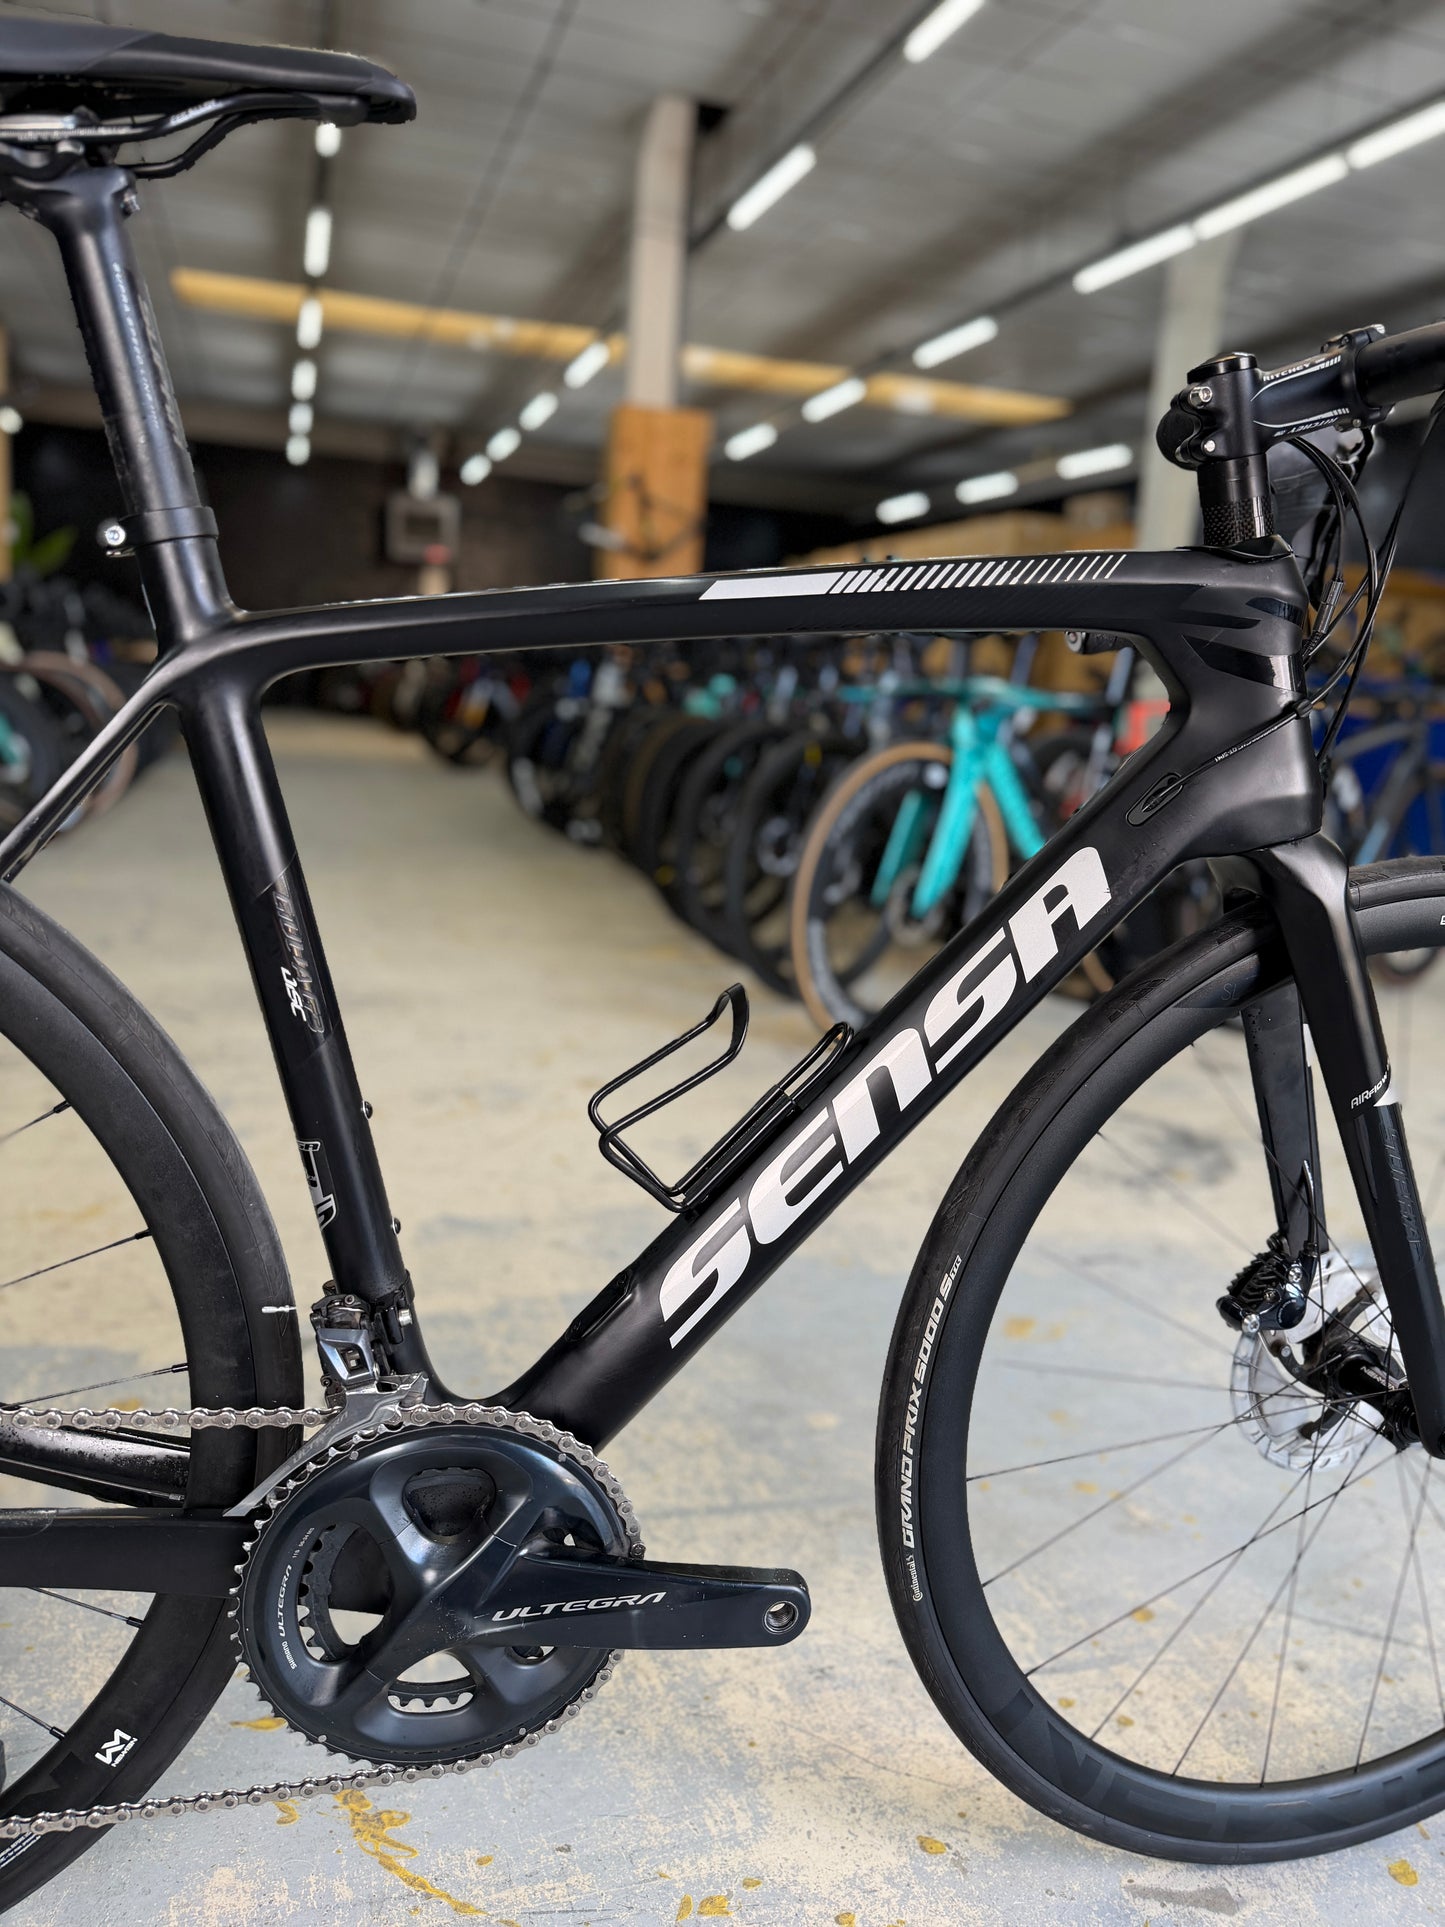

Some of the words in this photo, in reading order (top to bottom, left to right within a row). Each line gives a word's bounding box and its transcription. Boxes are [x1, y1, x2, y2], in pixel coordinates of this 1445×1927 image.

[1263, 363, 1311, 382] RITCHEY
[1287, 416, 1339, 435] RITCHEY
[940, 1273, 953, 1301] S
[913, 1297, 945, 1385] 5000
[902, 1382, 923, 1456] PRIX
[900, 1454, 915, 1549] GRAND
[906, 1559, 923, 1602] Continental
[277, 1564, 293, 1638] ULTEGRA
[491, 1591, 667, 1622] ULTEGRA
[281, 1640, 298, 1670] SHIMANO
